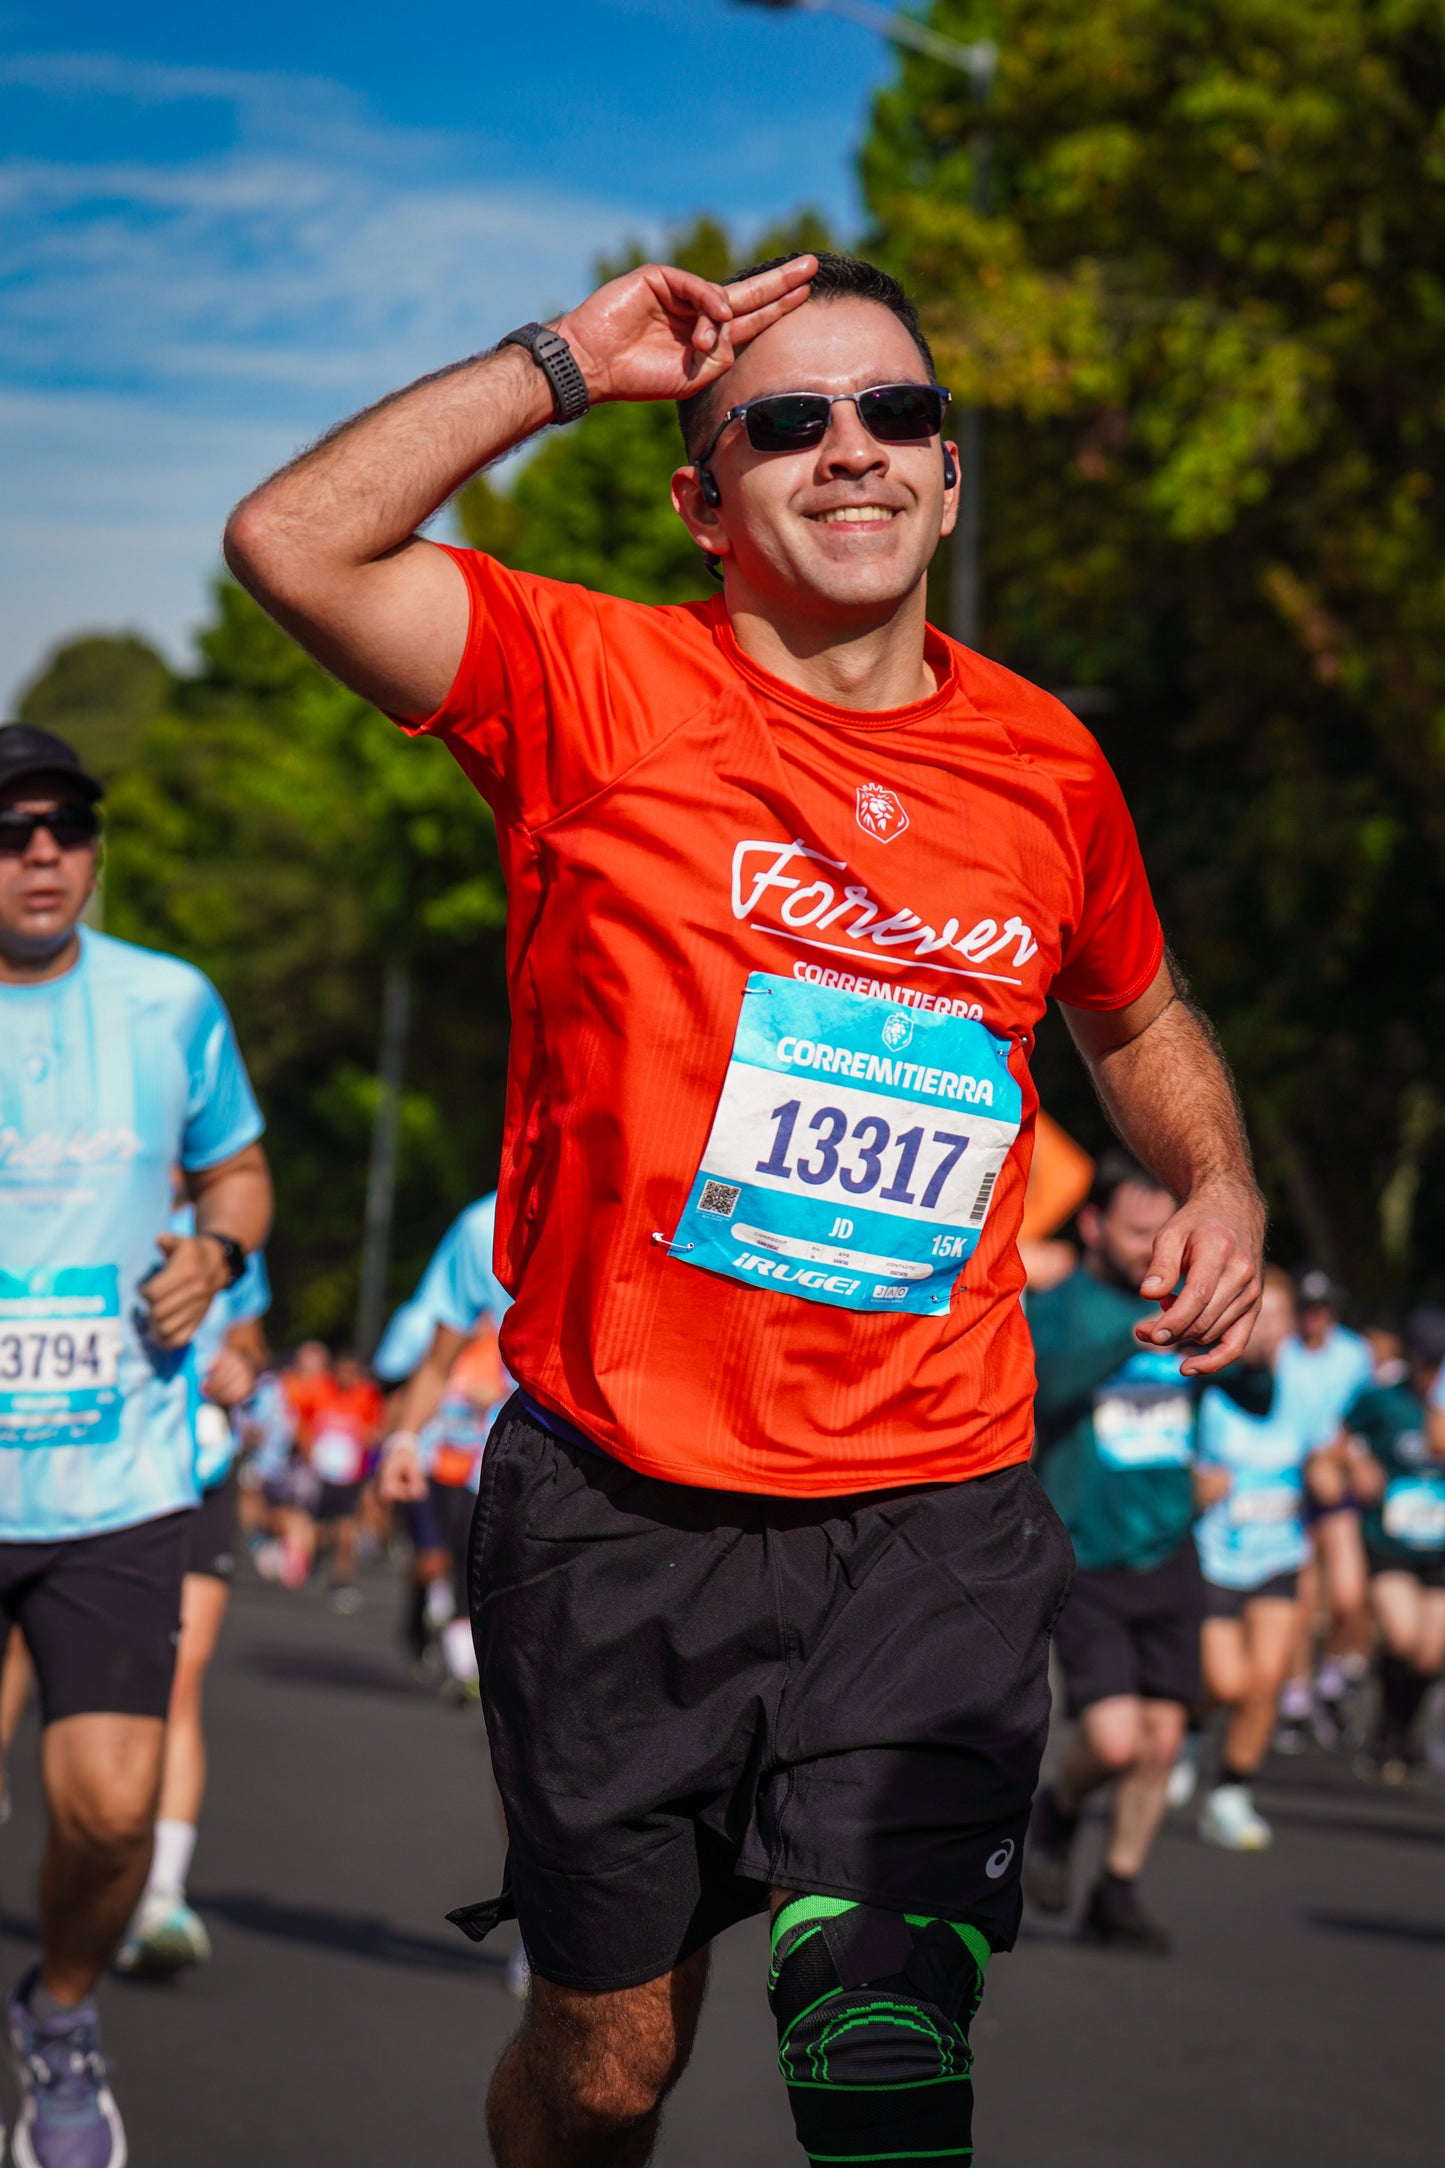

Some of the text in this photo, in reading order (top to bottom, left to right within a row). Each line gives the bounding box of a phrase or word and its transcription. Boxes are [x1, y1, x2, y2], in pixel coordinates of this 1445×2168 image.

[731, 838, 1038, 967] Forever
[792, 960, 984, 1022] CORREMITIERRA
[776, 1037, 994, 1107] CORREMITIERRA
[755, 1099, 970, 1209] 13317
[828, 1217, 854, 1239] JD
[931, 1234, 968, 1258] 15K
